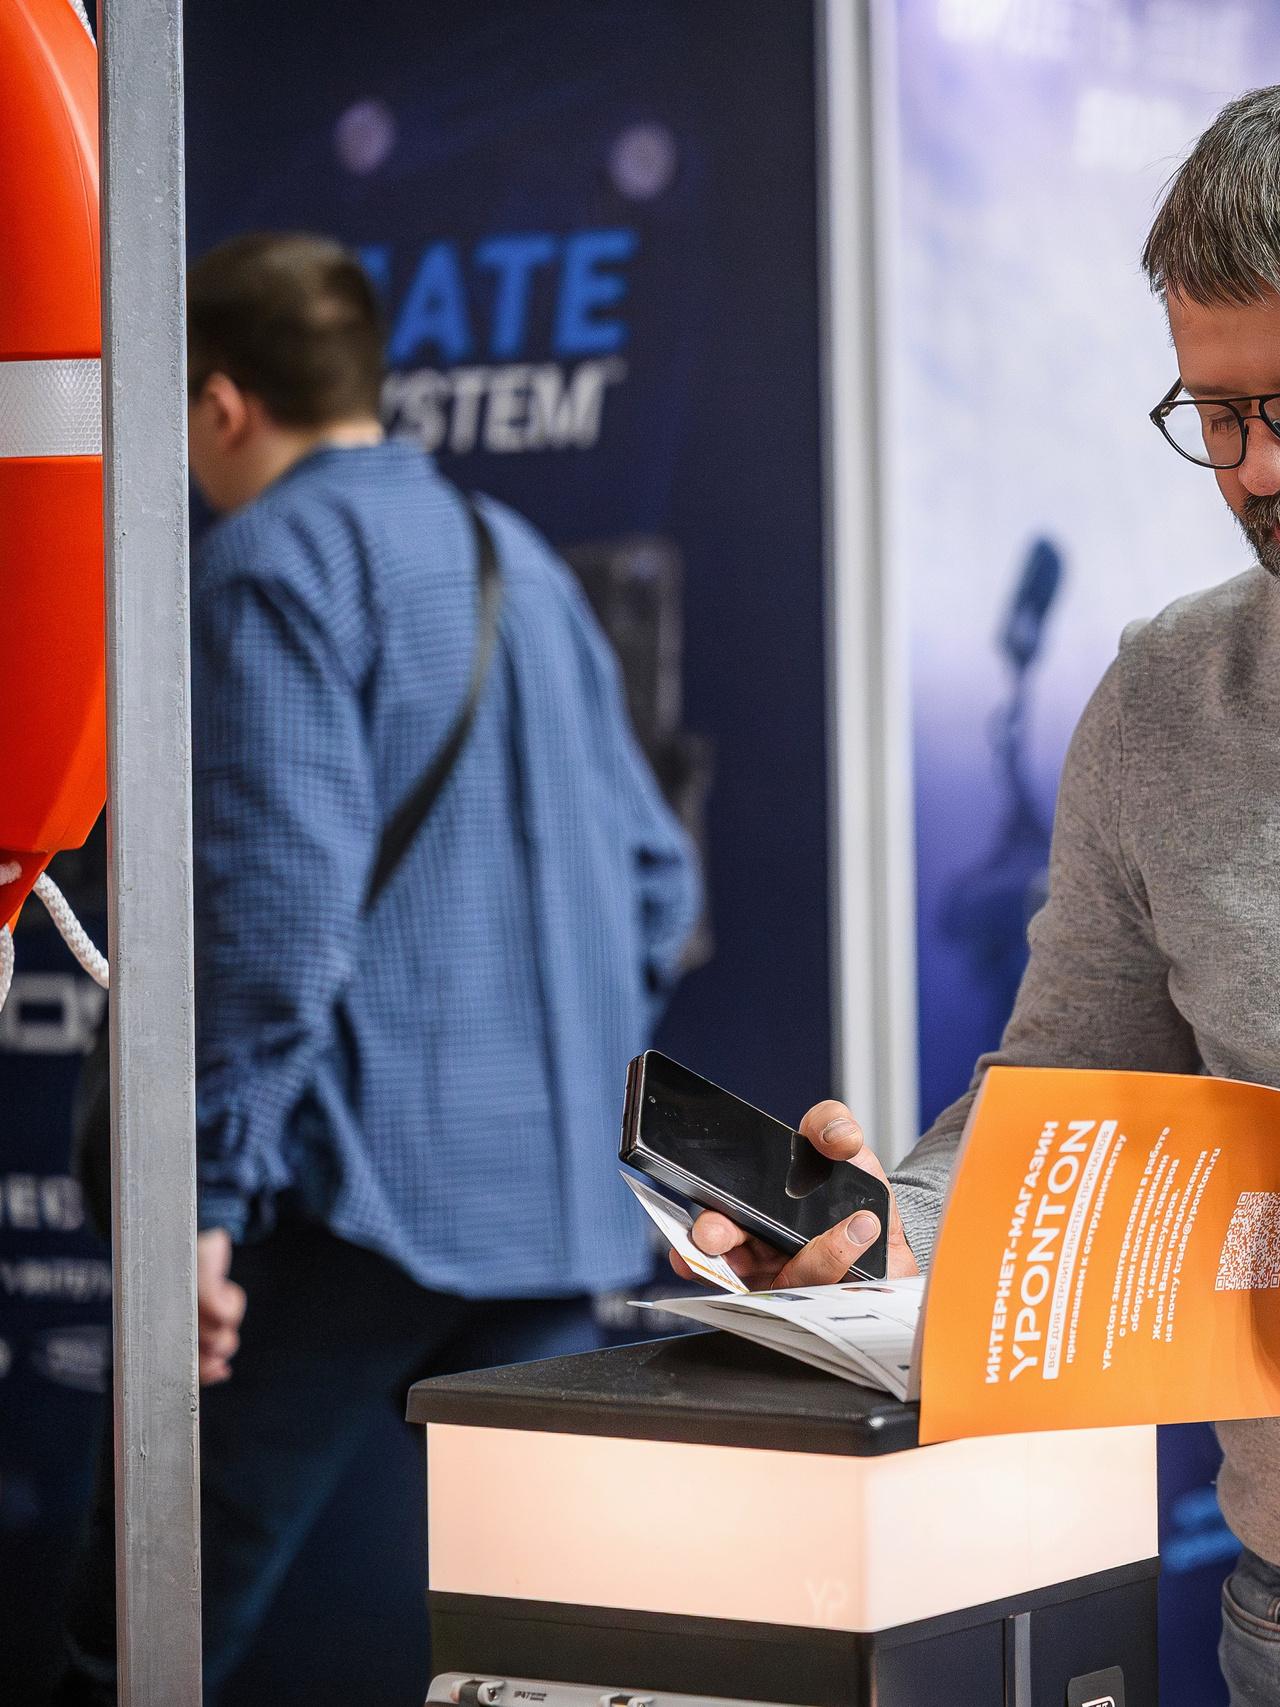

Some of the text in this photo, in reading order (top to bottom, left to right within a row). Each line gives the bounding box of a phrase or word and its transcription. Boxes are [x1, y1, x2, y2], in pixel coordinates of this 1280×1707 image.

[357, 226, 639, 364] ATE
[985, 1121, 1059, 1383] ИНТЕРНЕТ-МАГАЗИН
[1009, 1120, 1096, 1382] YPONTON
[1054, 1202, 1086, 1309] СТРОИТЕЛЬСТВА
[1066, 1134, 1127, 1364] приглашаем к сотрудничеству
[1080, 1130, 1109, 1198] ПРИЧАЛОВ
[1102, 1127, 1171, 1370] YPonton заинтересован в работе
[1118, 1154, 1169, 1337] с новыми поставщиками
[1152, 1150, 1208, 1340] Ждем Ваши предложения
[1153, 1158, 1180, 1217] товаров
[1164, 1147, 1221, 1343] на почту trade@yponton.ru
[1050, 1312, 1061, 1340] ДЛЯ
[1146, 1288, 1154, 1299] и
